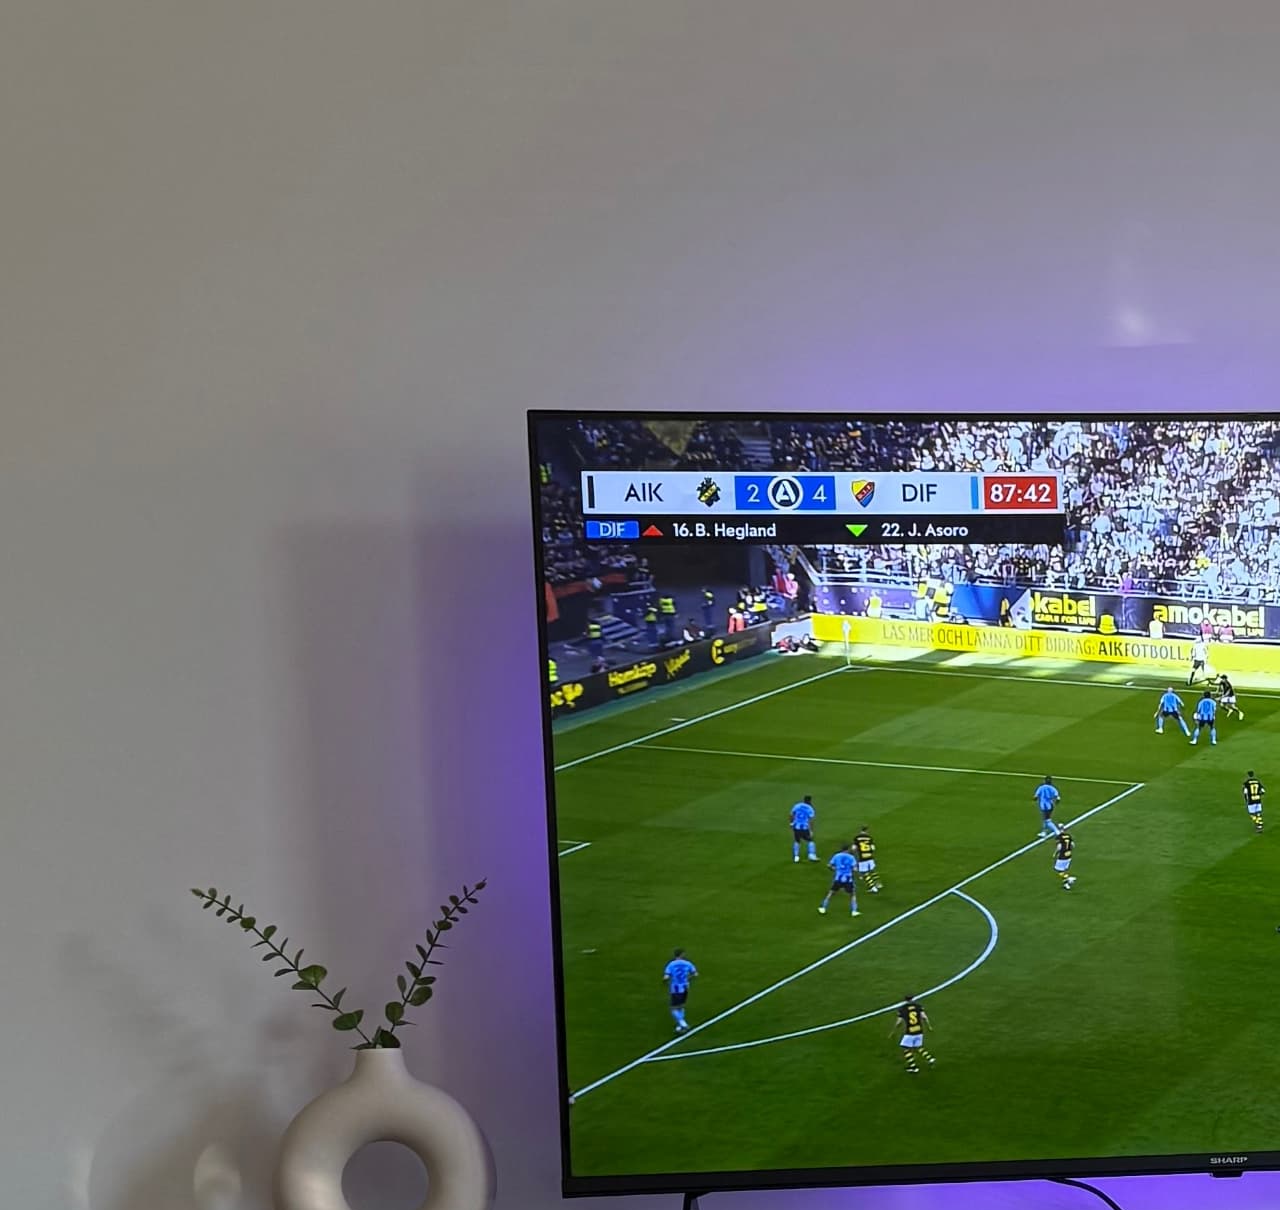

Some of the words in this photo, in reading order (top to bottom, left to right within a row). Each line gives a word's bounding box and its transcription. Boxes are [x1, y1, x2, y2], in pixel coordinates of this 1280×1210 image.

[624, 483, 664, 502] AIK
[747, 484, 760, 503] 2
[812, 484, 827, 503] 4
[902, 483, 937, 502] DIF
[990, 484, 1052, 503] 87:42
[714, 523, 776, 540] Hegland
[881, 523, 904, 537] 22.
[907, 523, 922, 537] J.
[925, 523, 969, 537] Asoro
[1153, 603, 1265, 628] amokabel
[937, 628, 964, 646] OCH
[1015, 635, 1042, 652] DITT
[1098, 640, 1196, 662] AIKFOTBOLL.
[1209, 1156, 1248, 1164] SHARP
